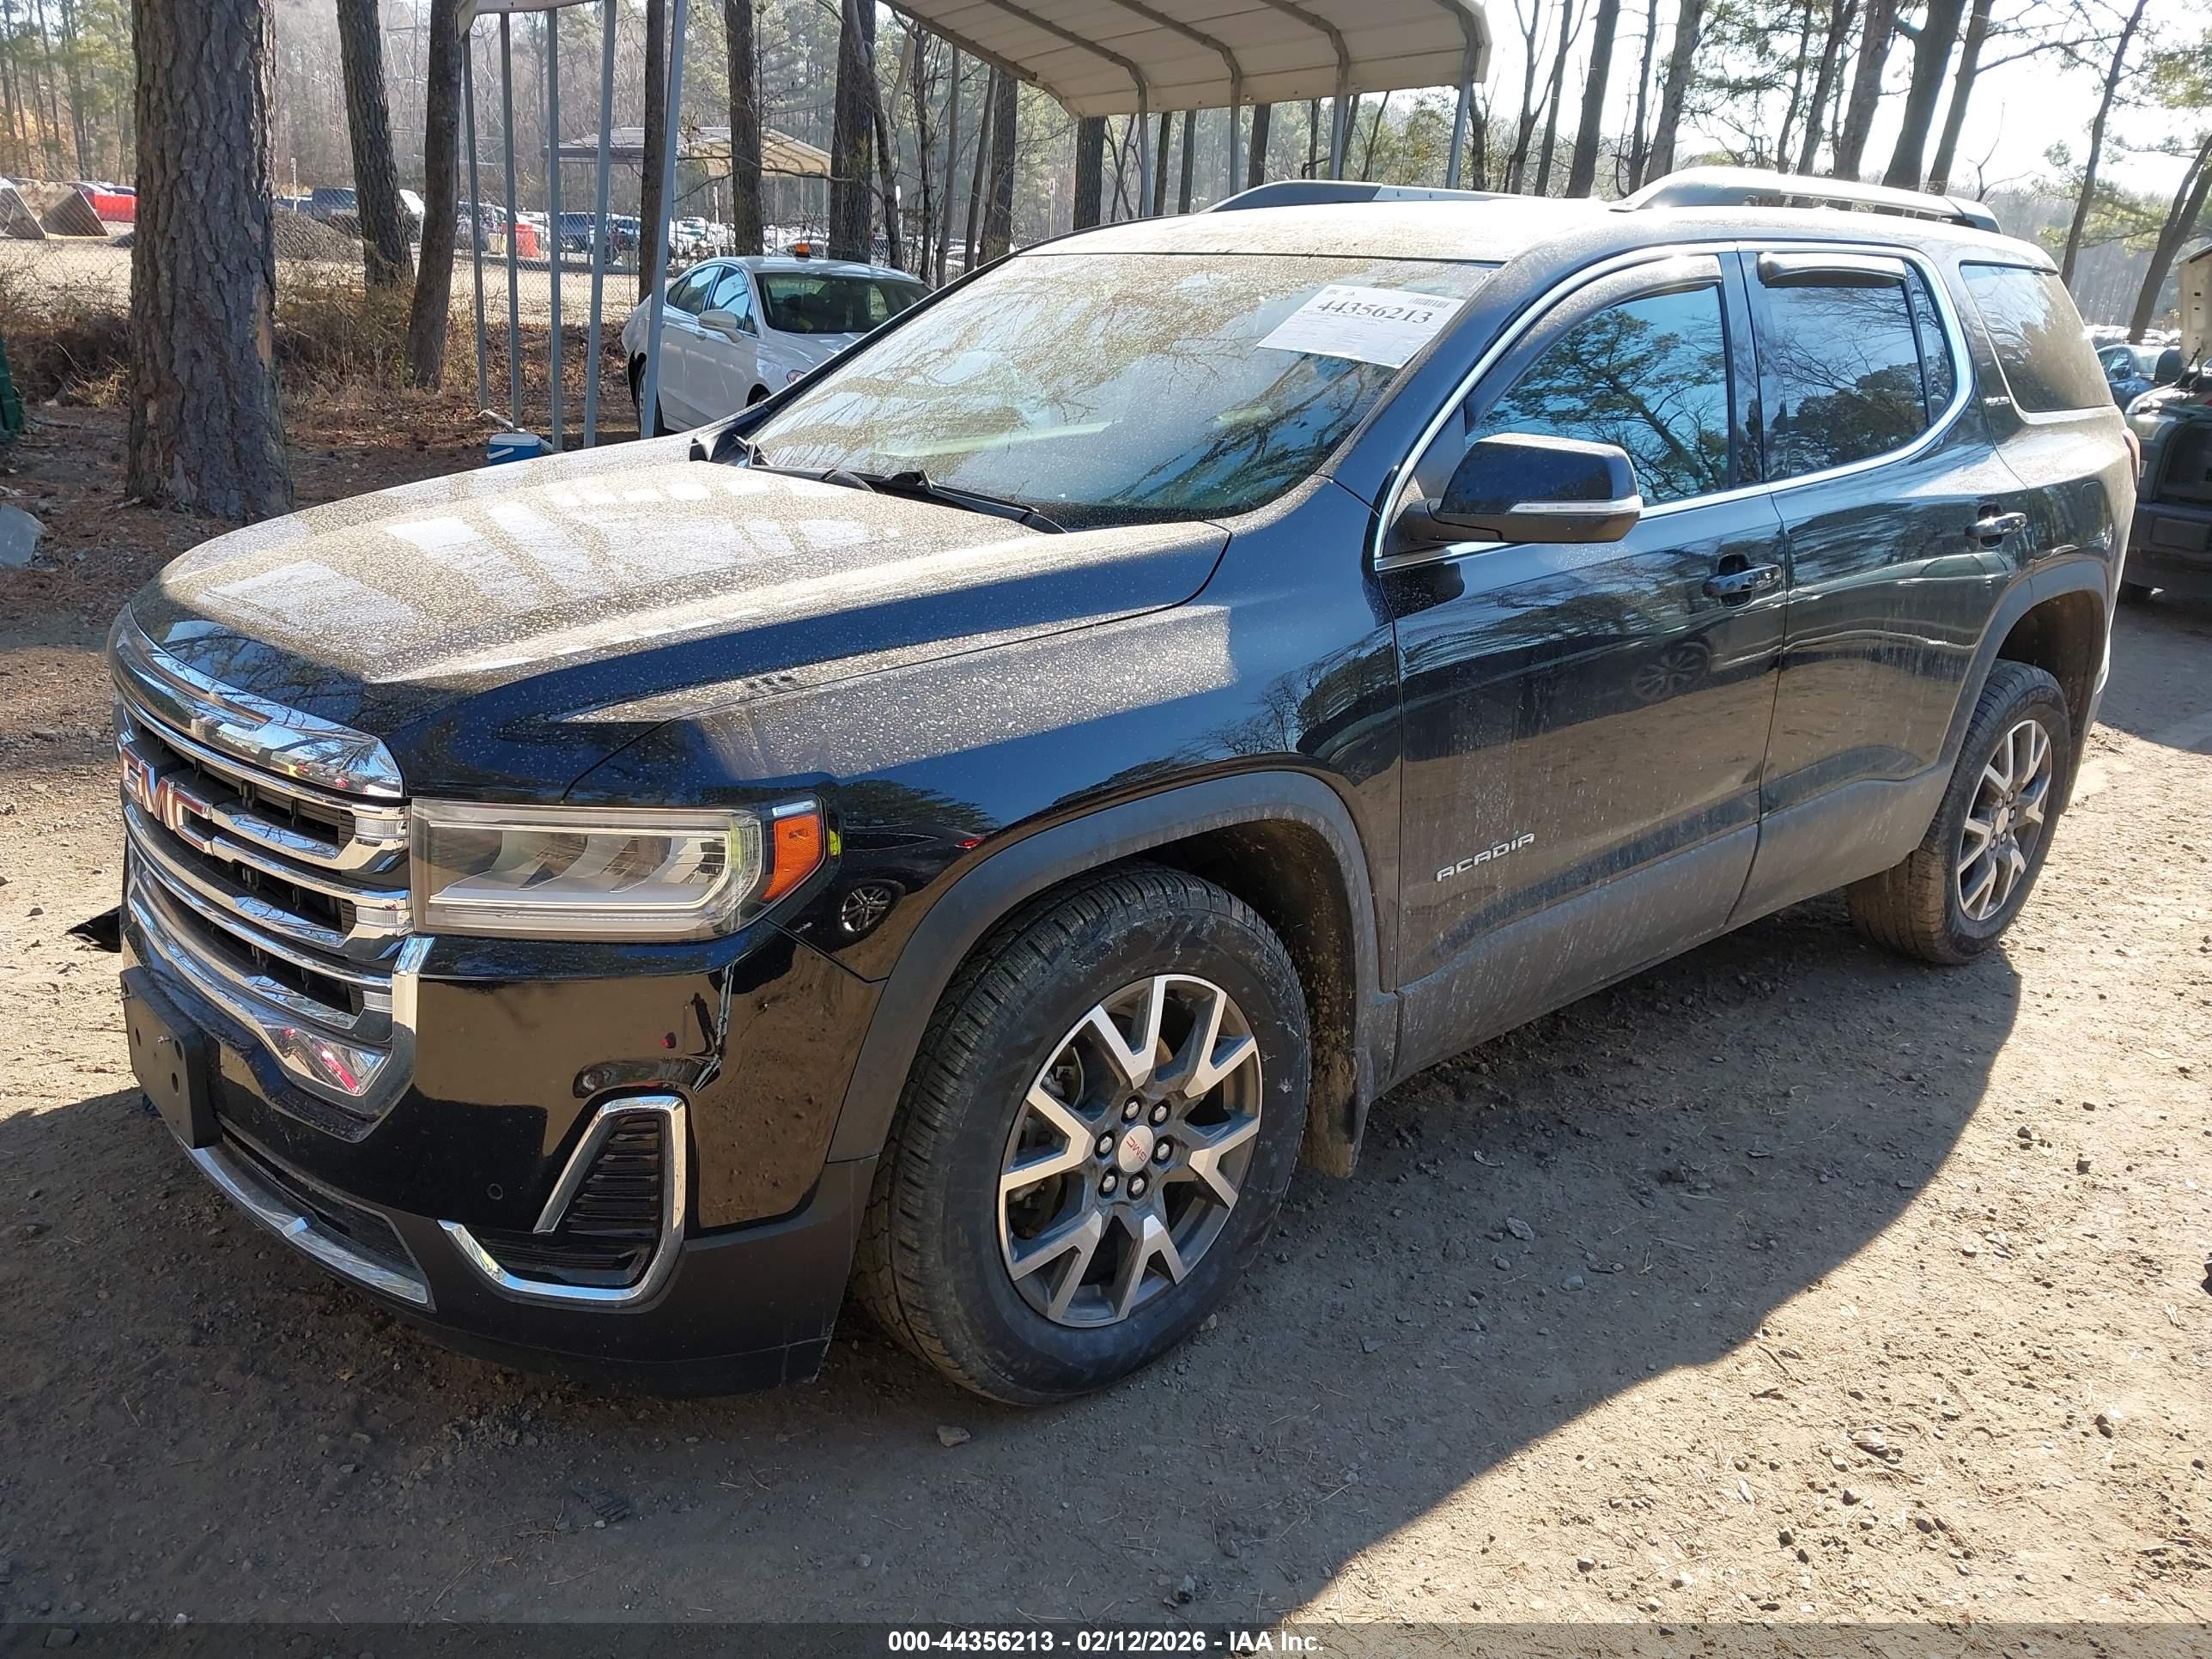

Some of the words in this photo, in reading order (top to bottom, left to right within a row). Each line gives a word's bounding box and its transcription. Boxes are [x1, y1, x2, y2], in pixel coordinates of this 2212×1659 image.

[1316, 300, 1434, 324] 44356213
[121, 745, 213, 855] GMC
[1436, 832, 1535, 883] ACADIA
[1126, 1136, 1147, 1162] GMC
